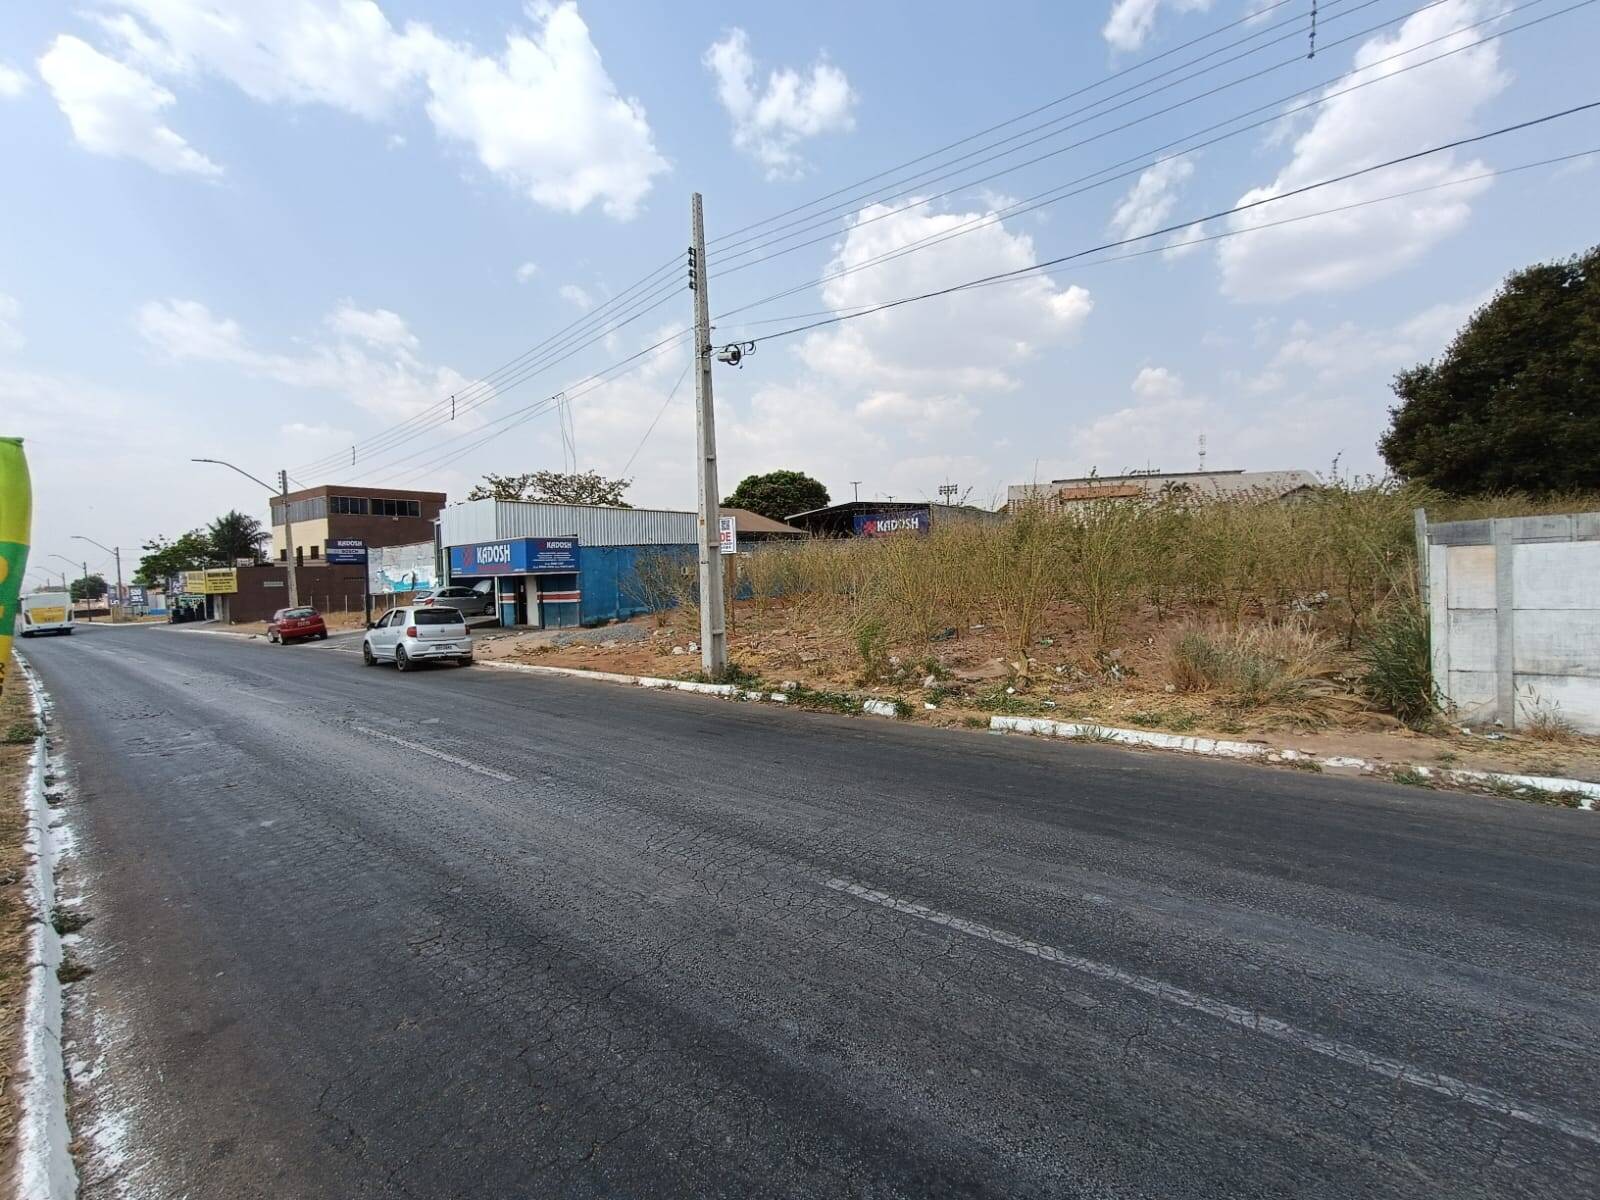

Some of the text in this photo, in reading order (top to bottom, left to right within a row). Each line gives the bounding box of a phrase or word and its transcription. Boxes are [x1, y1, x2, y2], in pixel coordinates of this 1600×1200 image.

[877, 517, 919, 532] KADOSH
[546, 541, 572, 549] KADOSH
[476, 544, 511, 564] KADOSH
